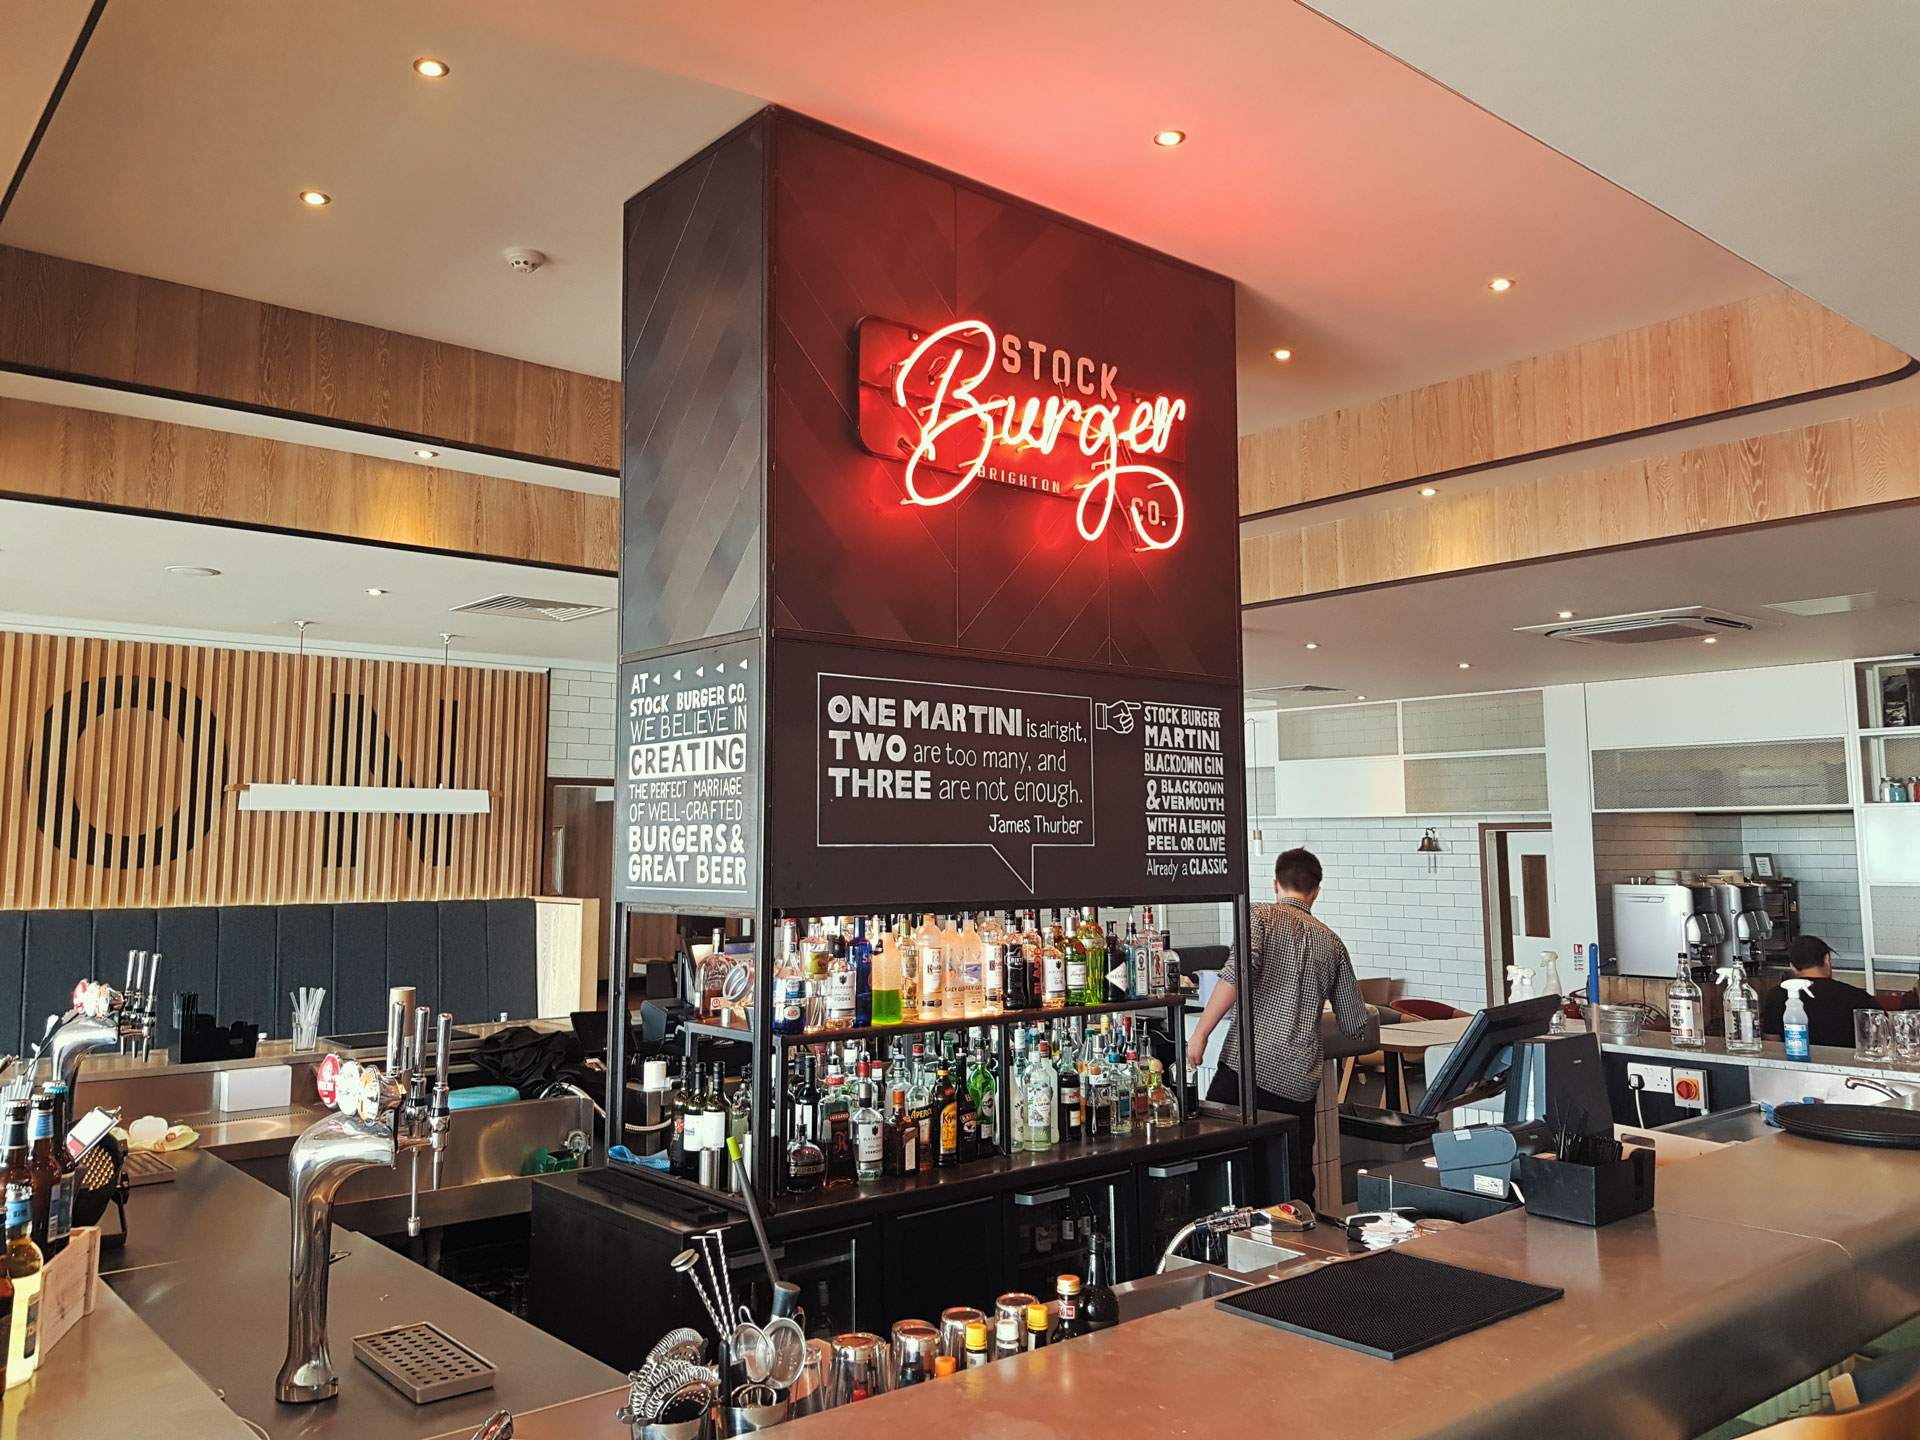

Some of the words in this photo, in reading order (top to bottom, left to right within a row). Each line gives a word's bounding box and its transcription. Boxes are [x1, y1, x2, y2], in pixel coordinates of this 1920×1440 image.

[1002, 334, 1118, 402] STOCK
[896, 320, 1186, 549] Burger
[977, 465, 1061, 494] BRIGHTON
[1131, 497, 1167, 526] CO.
[631, 673, 649, 695] AT
[630, 694, 670, 717] STOCK
[677, 685, 725, 711] BURGER
[728, 683, 747, 704] CO.
[630, 717, 656, 744] WE
[660, 707, 729, 739] BELIEVE
[734, 704, 747, 730] IN
[827, 695, 896, 727] ONE
[903, 699, 1022, 737] MARTINI
[1026, 718, 1037, 738] is
[1039, 720, 1087, 743] alright,
[1144, 706, 1180, 725] STOCK
[1181, 708, 1221, 728] BURGER
[828, 730, 907, 762] TWO
[913, 744, 941, 764] are
[945, 742, 977, 766] too
[983, 751, 1032, 774] many,
[1037, 749, 1066, 772] and
[1145, 725, 1220, 751] MARTINI
[631, 737, 744, 776] CREATING
[1144, 752, 1202, 774] BLACKDOWN
[1204, 756, 1224, 775] GIN
[629, 783, 648, 799] THE
[650, 780, 687, 799] PERFECT
[693, 777, 742, 797] MARRIAGE
[828, 767, 932, 800] THREE
[939, 779, 970, 800] are
[976, 777, 1009, 801] not
[1014, 780, 1083, 808] enough.
[1146, 779, 1160, 810] &
[1161, 779, 1224, 795] BLACKDOWN
[629, 802, 645, 822] OF
[648, 799, 742, 822] WELL-CRAFTED
[1161, 795, 1225, 811] VERMOUTH
[628, 823, 727, 853] BURGERS
[730, 824, 745, 853] &
[989, 814, 1030, 834] James
[1033, 815, 1083, 834] Thurber
[1146, 817, 1177, 833] WITH
[1179, 818, 1187, 833] A
[1188, 819, 1226, 835] LEMON
[1147, 835, 1179, 851] PEEL
[1180, 837, 1195, 851] OR
[1196, 836, 1226, 852] OLIVE
[628, 853, 689, 882] GREAT
[696, 855, 747, 885] BEER
[1146, 857, 1178, 882] Already
[1181, 863, 1188, 875] a
[1189, 858, 1228, 875] CLASSIC
